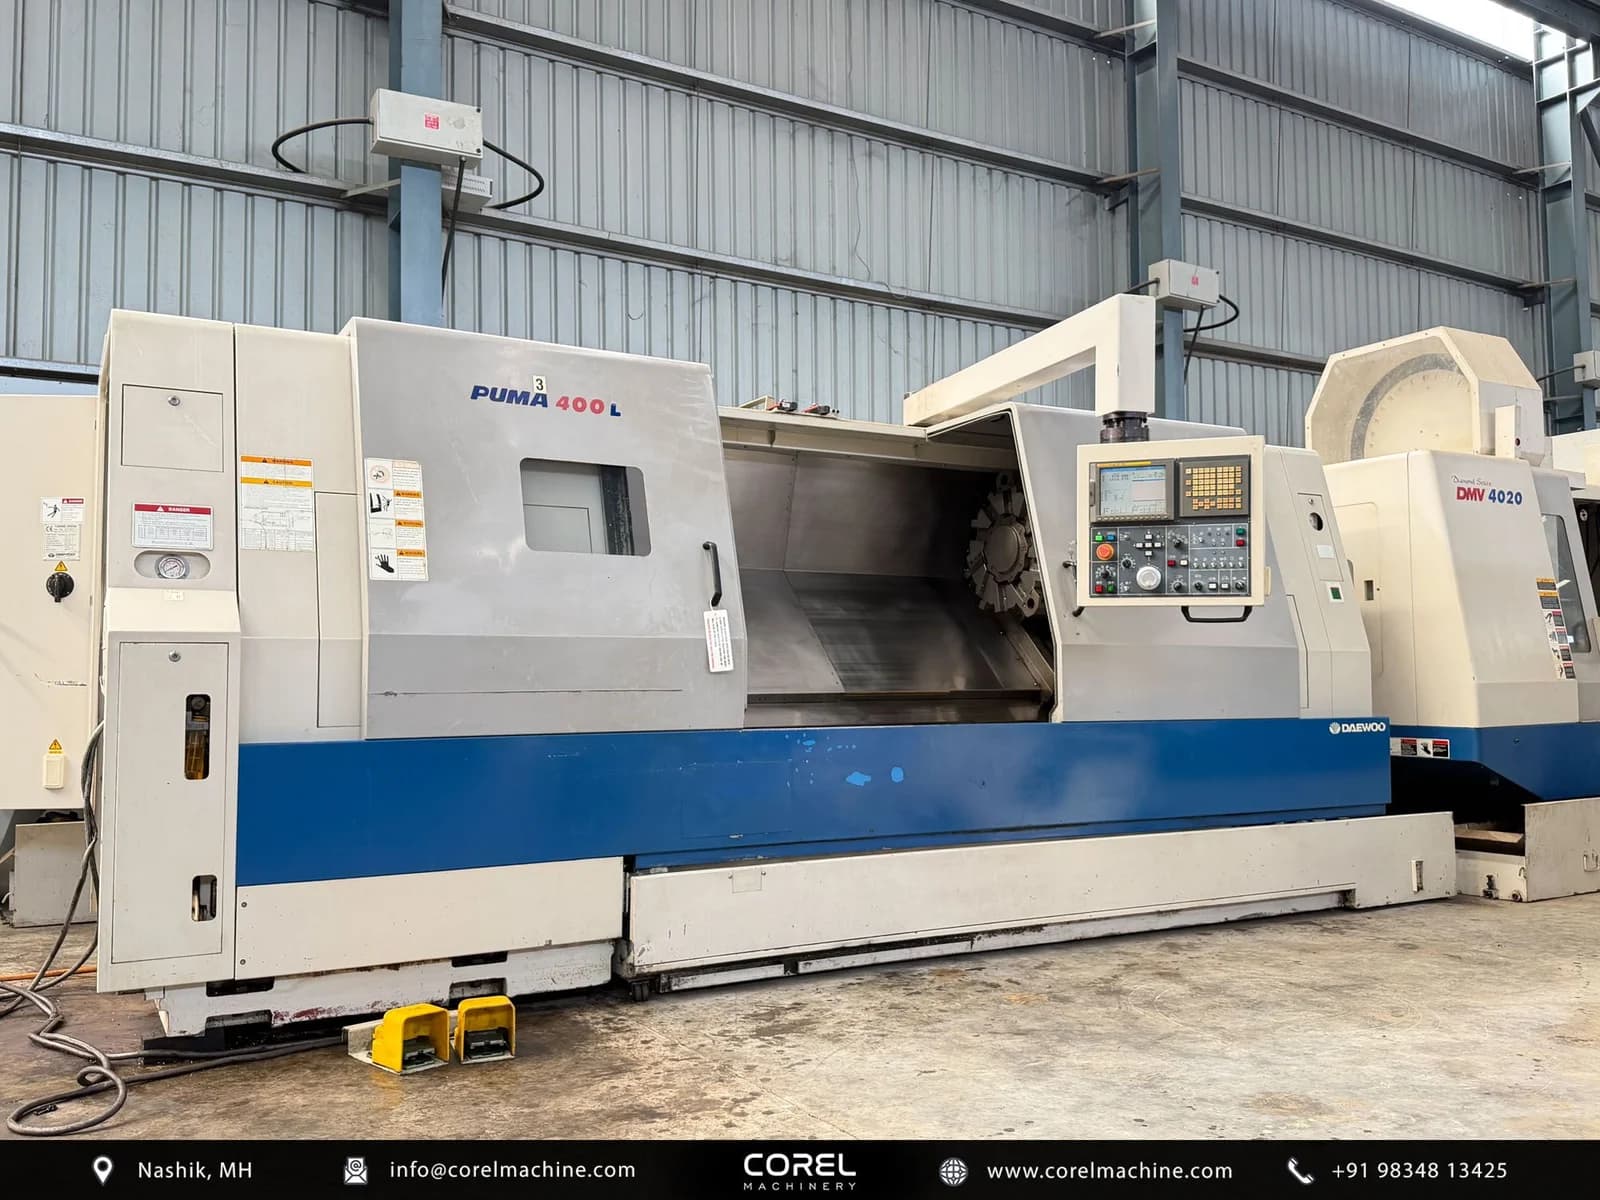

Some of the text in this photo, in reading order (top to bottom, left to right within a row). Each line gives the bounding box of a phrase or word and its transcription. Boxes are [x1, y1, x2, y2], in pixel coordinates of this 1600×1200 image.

[535, 378, 544, 391] 3
[470, 385, 621, 417] PUMA 400 L
[1456, 486, 1523, 506] DMV 4020
[1341, 721, 1386, 733] DAEWOO
